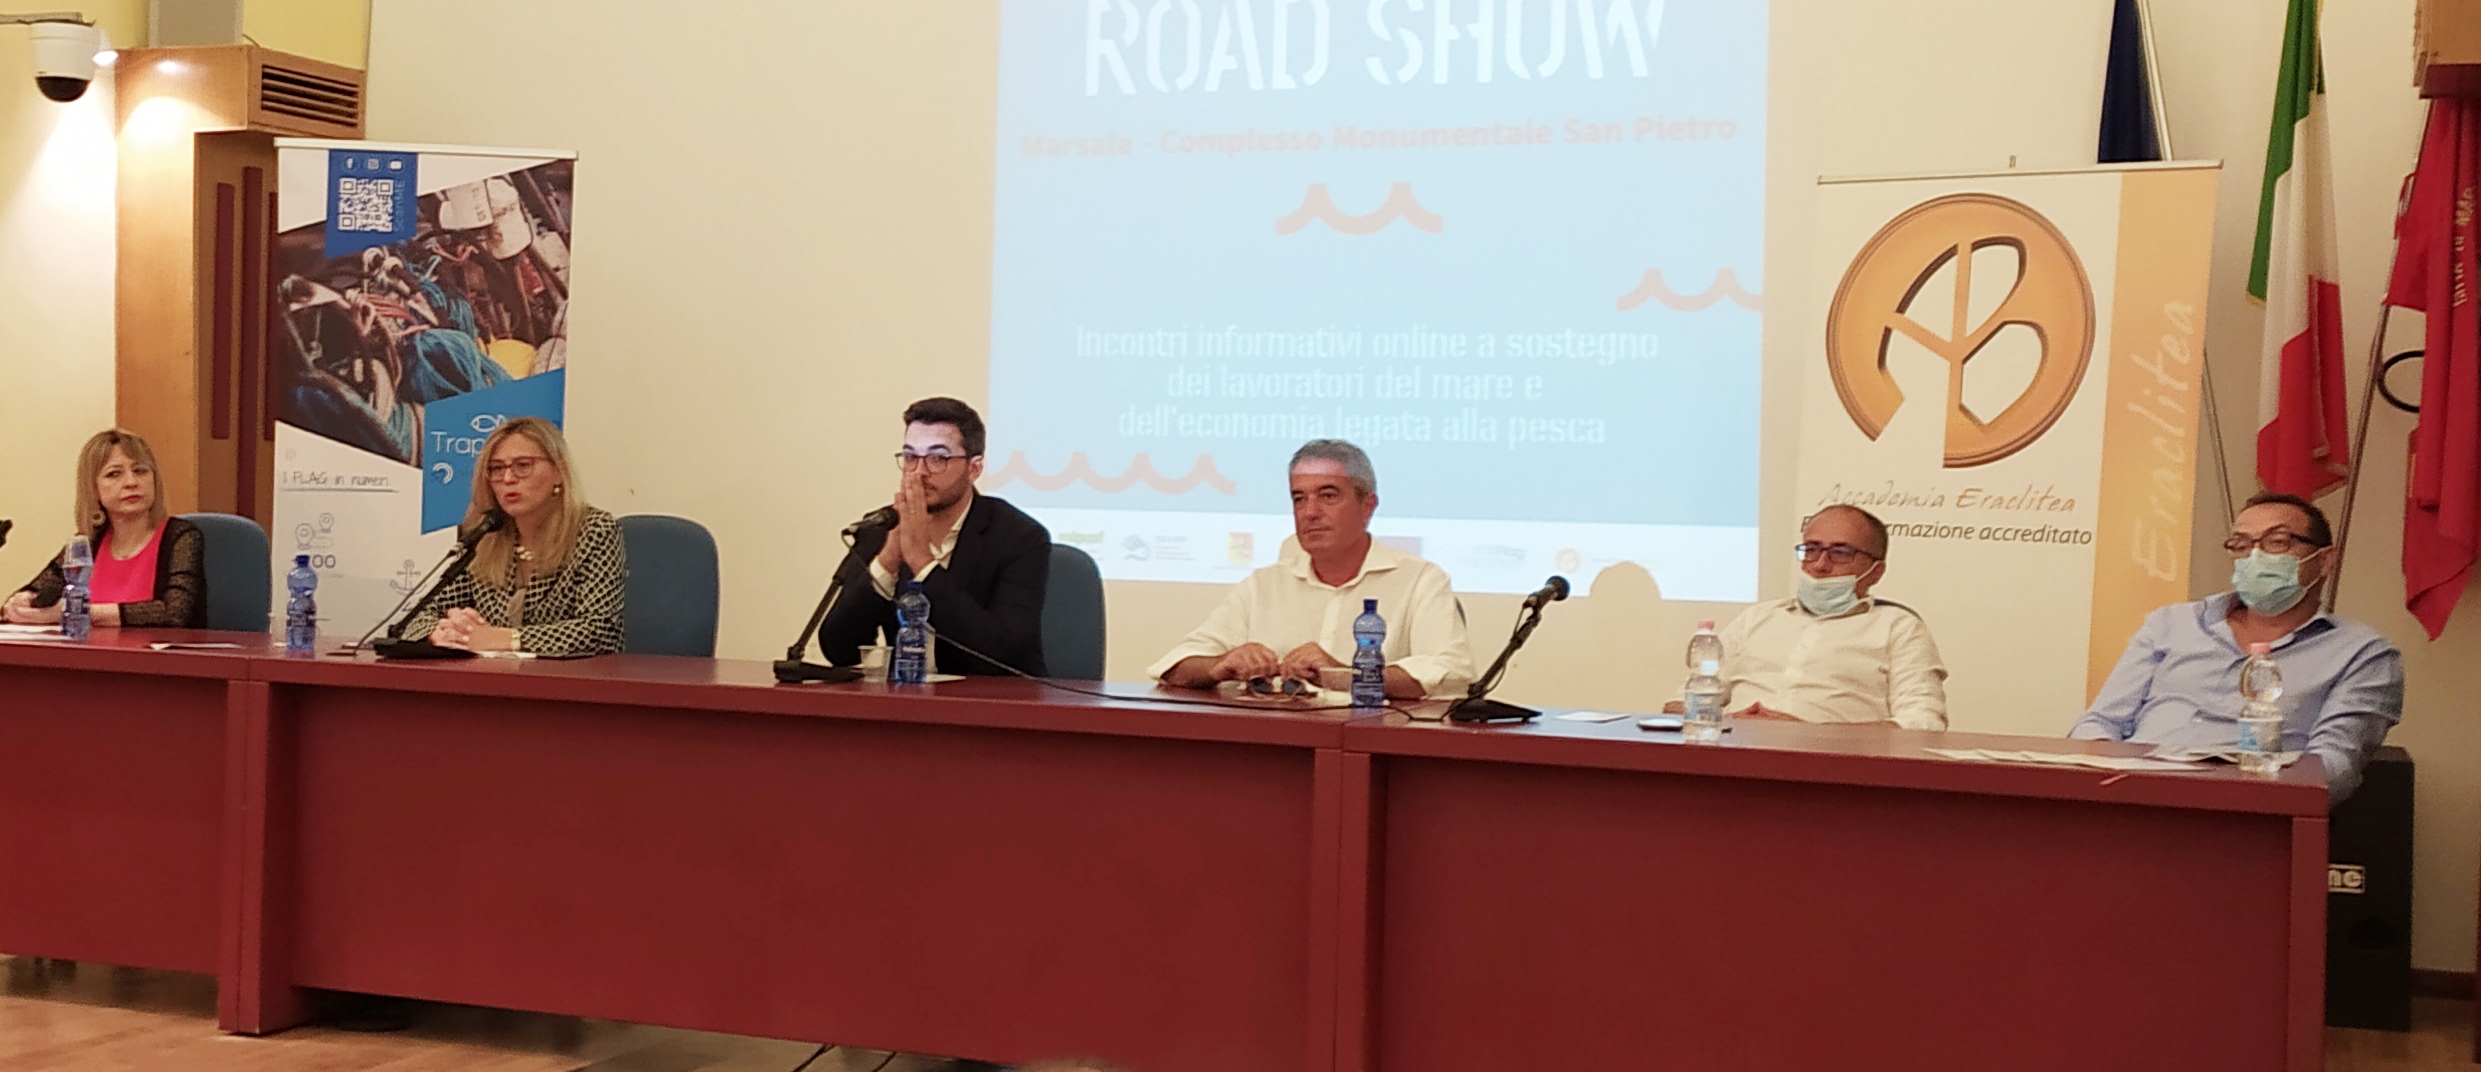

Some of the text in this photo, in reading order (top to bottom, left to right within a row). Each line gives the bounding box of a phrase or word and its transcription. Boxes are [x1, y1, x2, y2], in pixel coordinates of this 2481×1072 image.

[1085, 0, 1666, 96] ROAD SHOW
[1019, 130, 1133, 157] Marsala
[1160, 126, 1324, 159] Complesso
[1333, 118, 1553, 149] Monumentale
[1562, 118, 1624, 144] San
[1634, 115, 1738, 142] Pietro
[1076, 323, 1659, 366] Incontri informativi online a sostegno
[1168, 364, 1543, 400] dei lavoratori del mare e
[1118, 404, 1605, 451] dell'economia legata alla pesca
[2127, 301, 2194, 581] Eraclitea
[293, 470, 328, 485] FLAG
[1817, 479, 2076, 513] Accademia Eraclitea
[1886, 520, 2093, 546] rmazione accreditato
